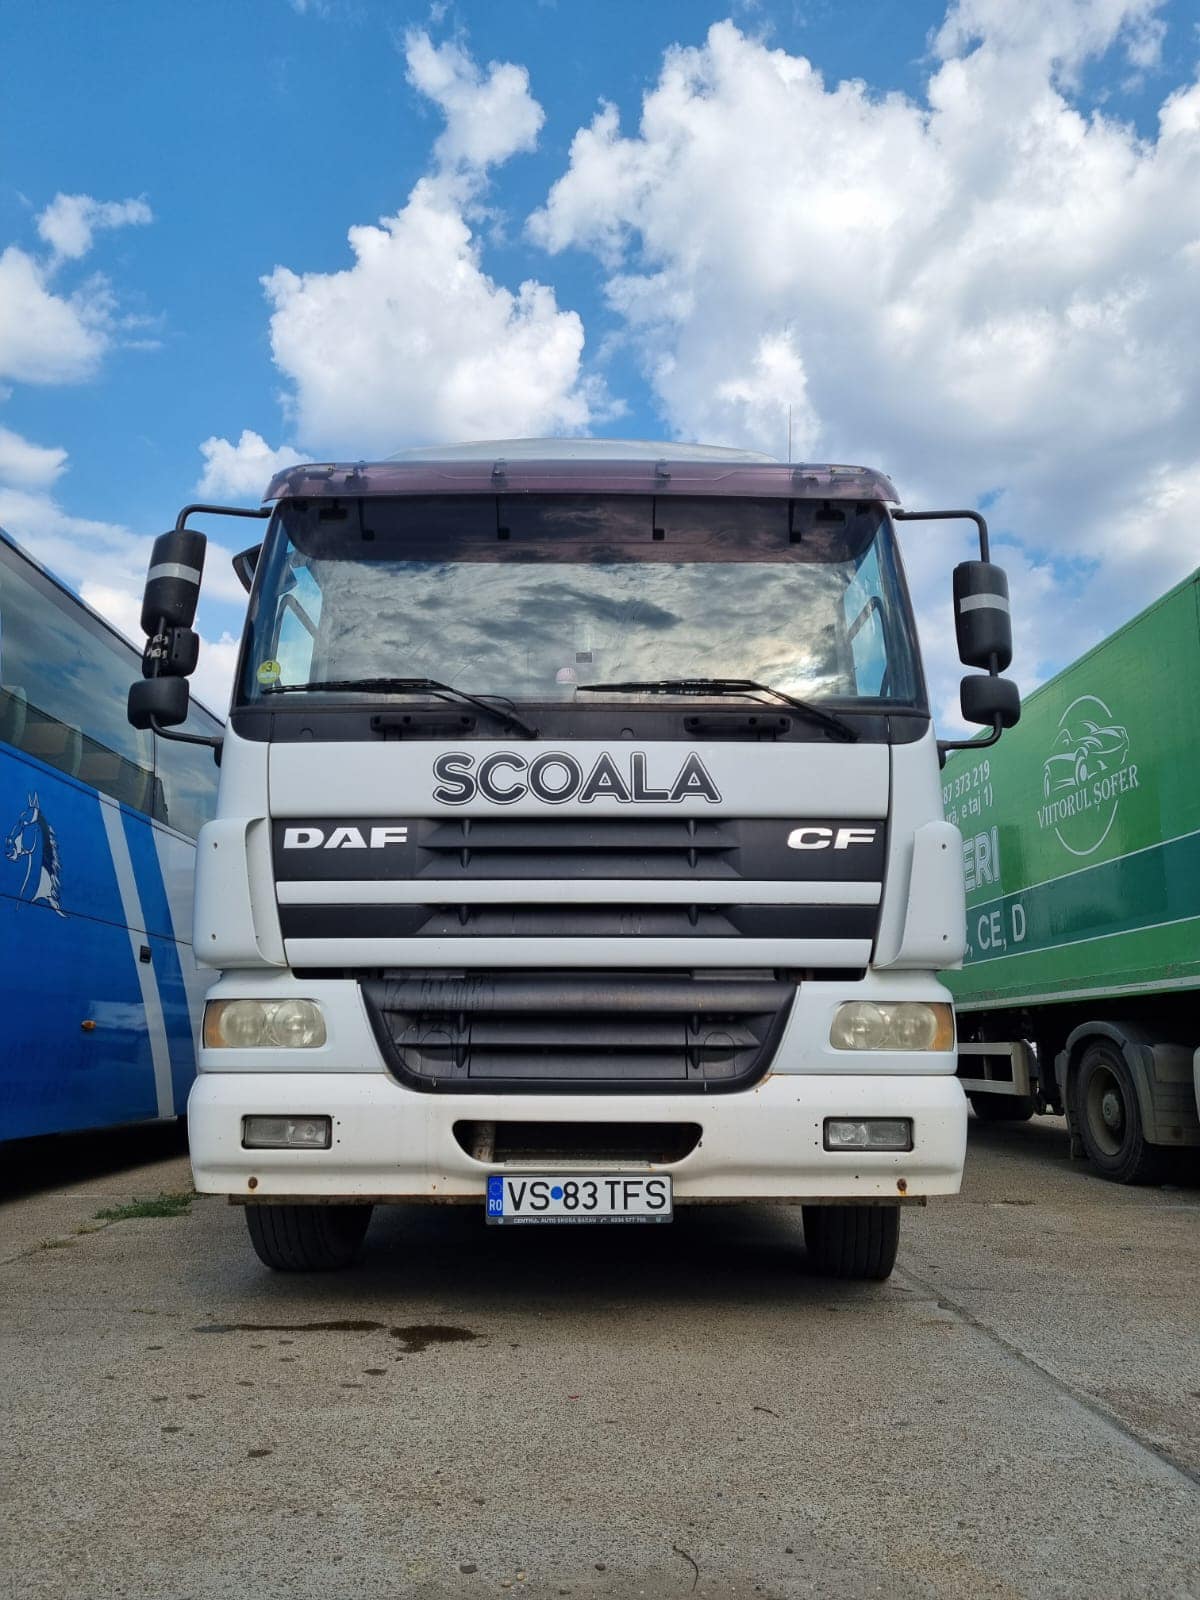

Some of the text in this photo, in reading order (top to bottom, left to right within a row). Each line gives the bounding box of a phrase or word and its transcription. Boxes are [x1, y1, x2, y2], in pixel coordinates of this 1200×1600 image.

[432, 751, 722, 806] SCOALA
[955, 772, 970, 798] 373
[973, 760, 989, 787] 219
[983, 782, 993, 807] 1)
[1037, 764, 1139, 829] VIITORUL ȘOFER
[283, 827, 408, 848] DAF
[787, 827, 876, 849] CF
[977, 904, 1025, 951] CE, D
[489, 1199, 502, 1211] RO
[508, 1180, 666, 1211] VS 83 TFS
